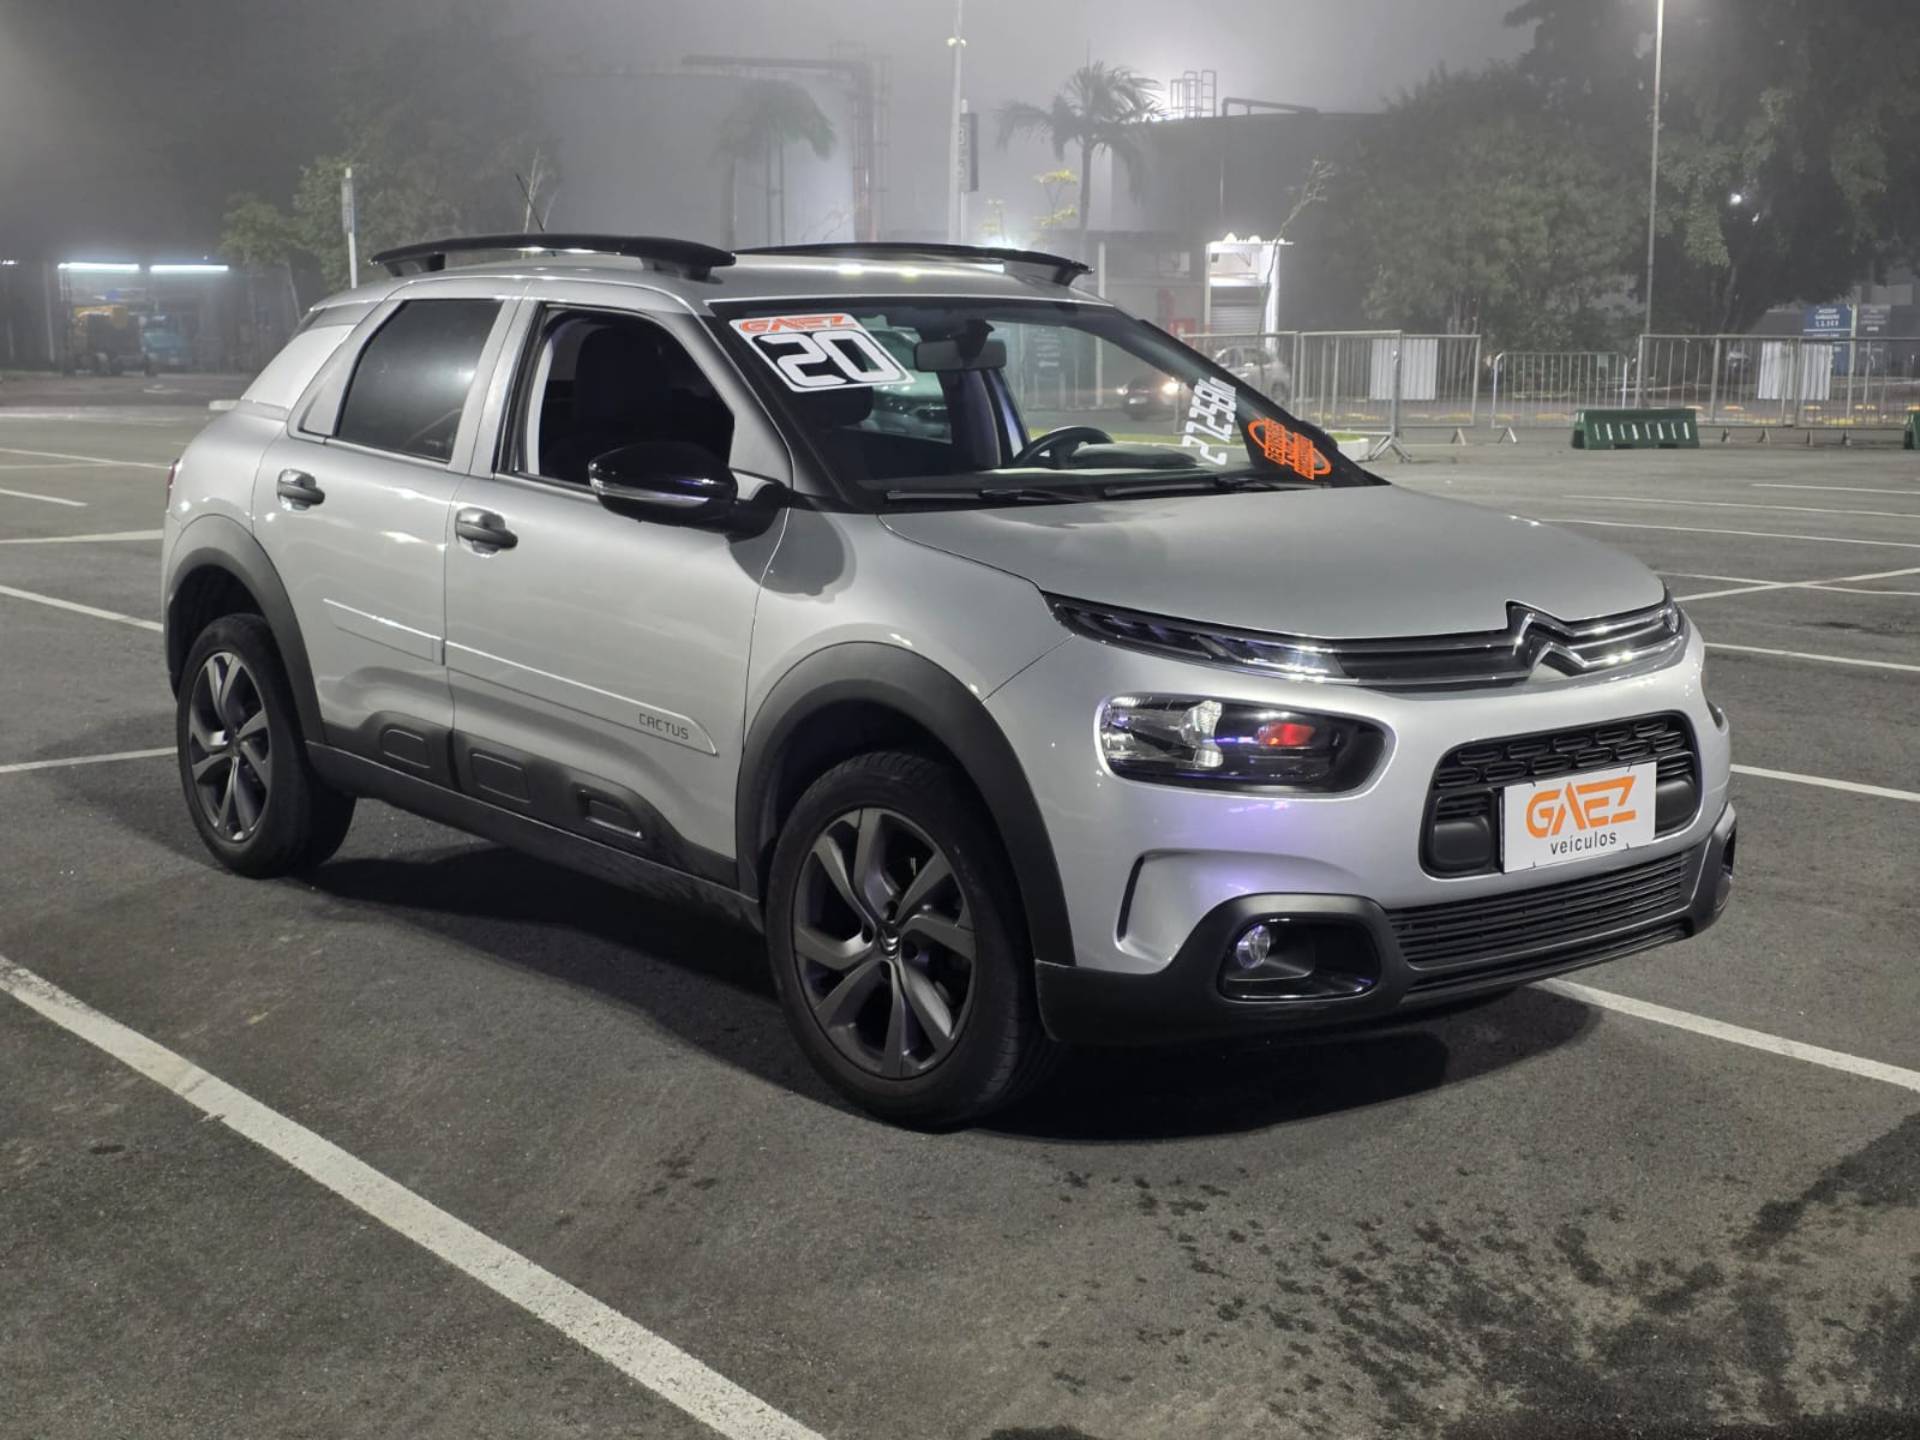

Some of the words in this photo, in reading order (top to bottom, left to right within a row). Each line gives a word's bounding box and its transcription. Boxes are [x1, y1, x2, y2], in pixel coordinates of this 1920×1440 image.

[756, 329, 902, 388] 20
[638, 713, 689, 740] CACTUS
[1526, 775, 1636, 839] GAEZ
